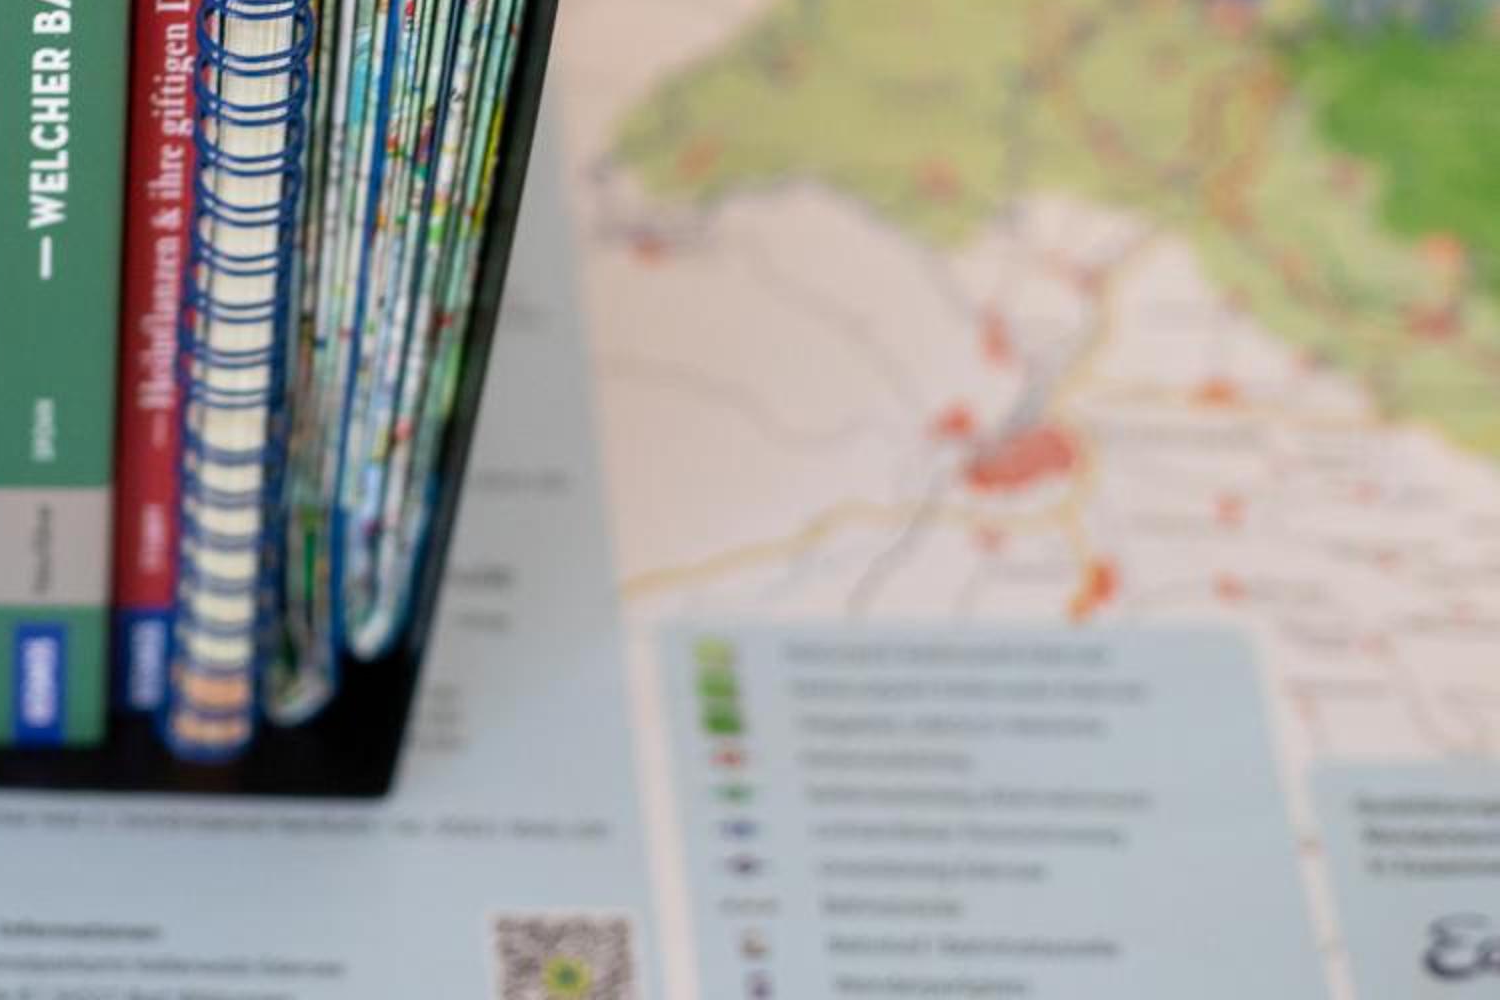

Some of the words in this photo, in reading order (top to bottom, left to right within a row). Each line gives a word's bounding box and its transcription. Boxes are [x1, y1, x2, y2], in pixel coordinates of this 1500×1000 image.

[151, 23, 198, 137] giftigen
[28, 47, 70, 230] WELCHER
[148, 143, 185, 200] ihre
